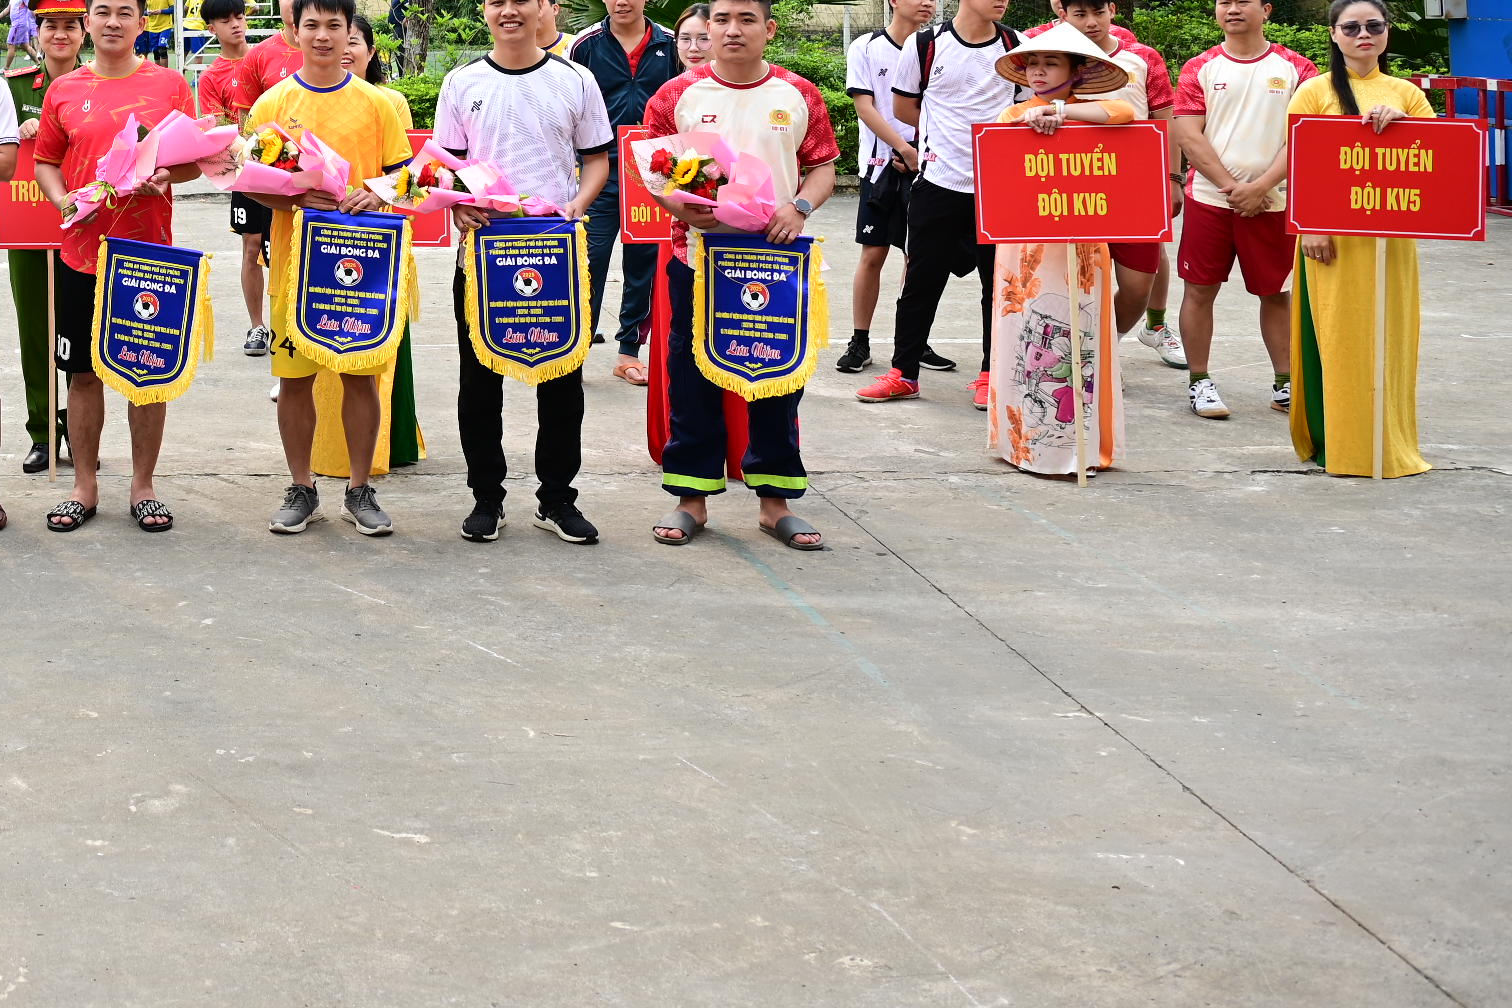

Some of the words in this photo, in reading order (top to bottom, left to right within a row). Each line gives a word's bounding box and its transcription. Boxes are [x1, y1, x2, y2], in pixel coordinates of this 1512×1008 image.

[1024, 149, 1055, 181] ĐỘI
[1059, 143, 1117, 176] TUYỂN
[1339, 142, 1370, 174] ĐỘI
[1375, 139, 1433, 172] TUYỂN
[1038, 188, 1068, 221] ĐỘI
[1073, 192, 1108, 216] KV6
[1350, 182, 1381, 214] ĐỘI
[1386, 187, 1421, 212] KV5
[233, 207, 247, 225] 19
[631, 203, 651, 226] ĐỘI
[655, 206, 661, 222] 1
[321, 244, 340, 254] GIẢI
[340, 247, 366, 257] BÓNG
[367, 249, 380, 258] ĐÁ
[496, 256, 515, 266] GIẢI
[516, 256, 543, 266] BÓNG
[544, 255, 558, 265] ĐÁ
[724, 268, 745, 278] GIẢI
[746, 270, 772, 280] BÓNG
[772, 272, 788, 282] ĐÁ
[122, 277, 139, 288] GIẢI
[140, 280, 163, 292] BÓNG
[164, 284, 176, 294] ĐÁ
